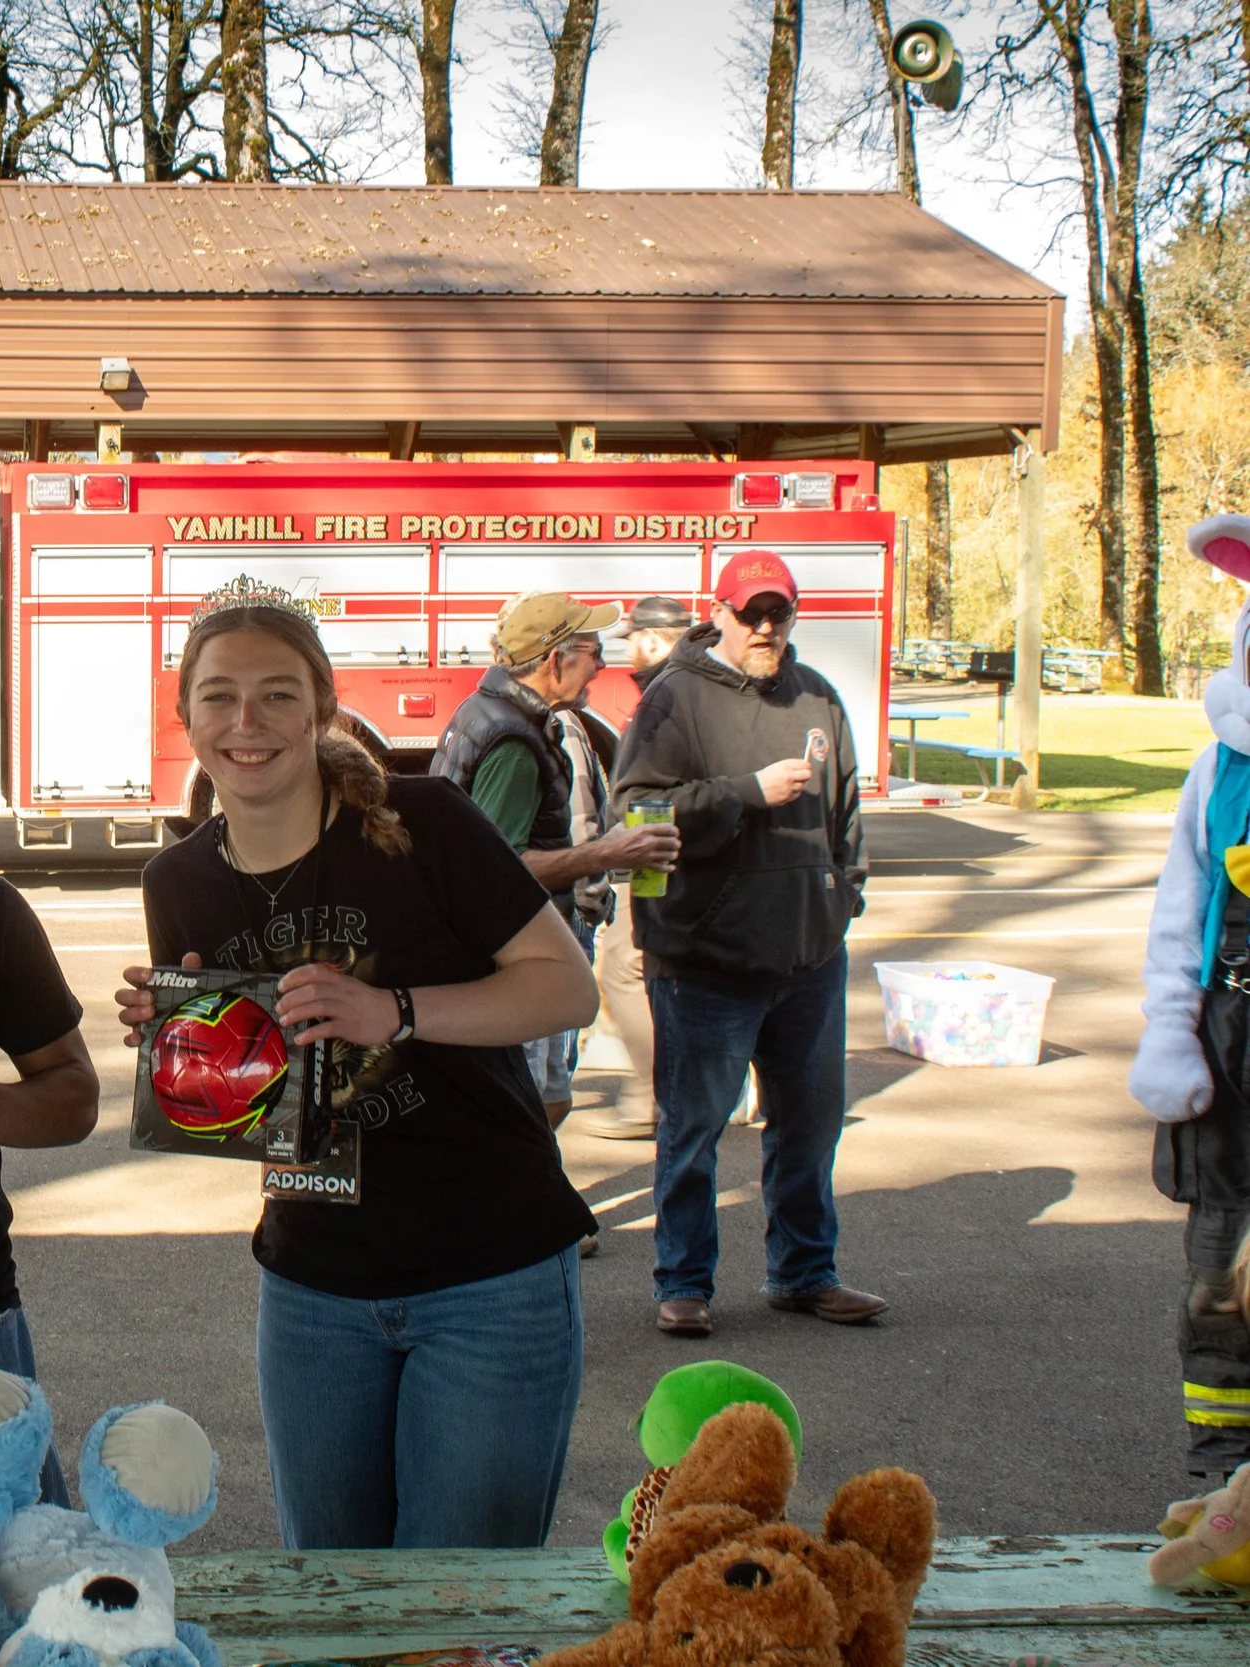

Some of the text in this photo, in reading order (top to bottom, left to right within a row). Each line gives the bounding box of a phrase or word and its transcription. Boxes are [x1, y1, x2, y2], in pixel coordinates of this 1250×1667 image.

[166, 514, 758, 541] YAMHILL FIRE PROTECTION DISTRICT
[214, 905, 368, 971] TIGER
[277, 1130, 285, 1142] 3
[265, 1170, 356, 1195] ADDISON
